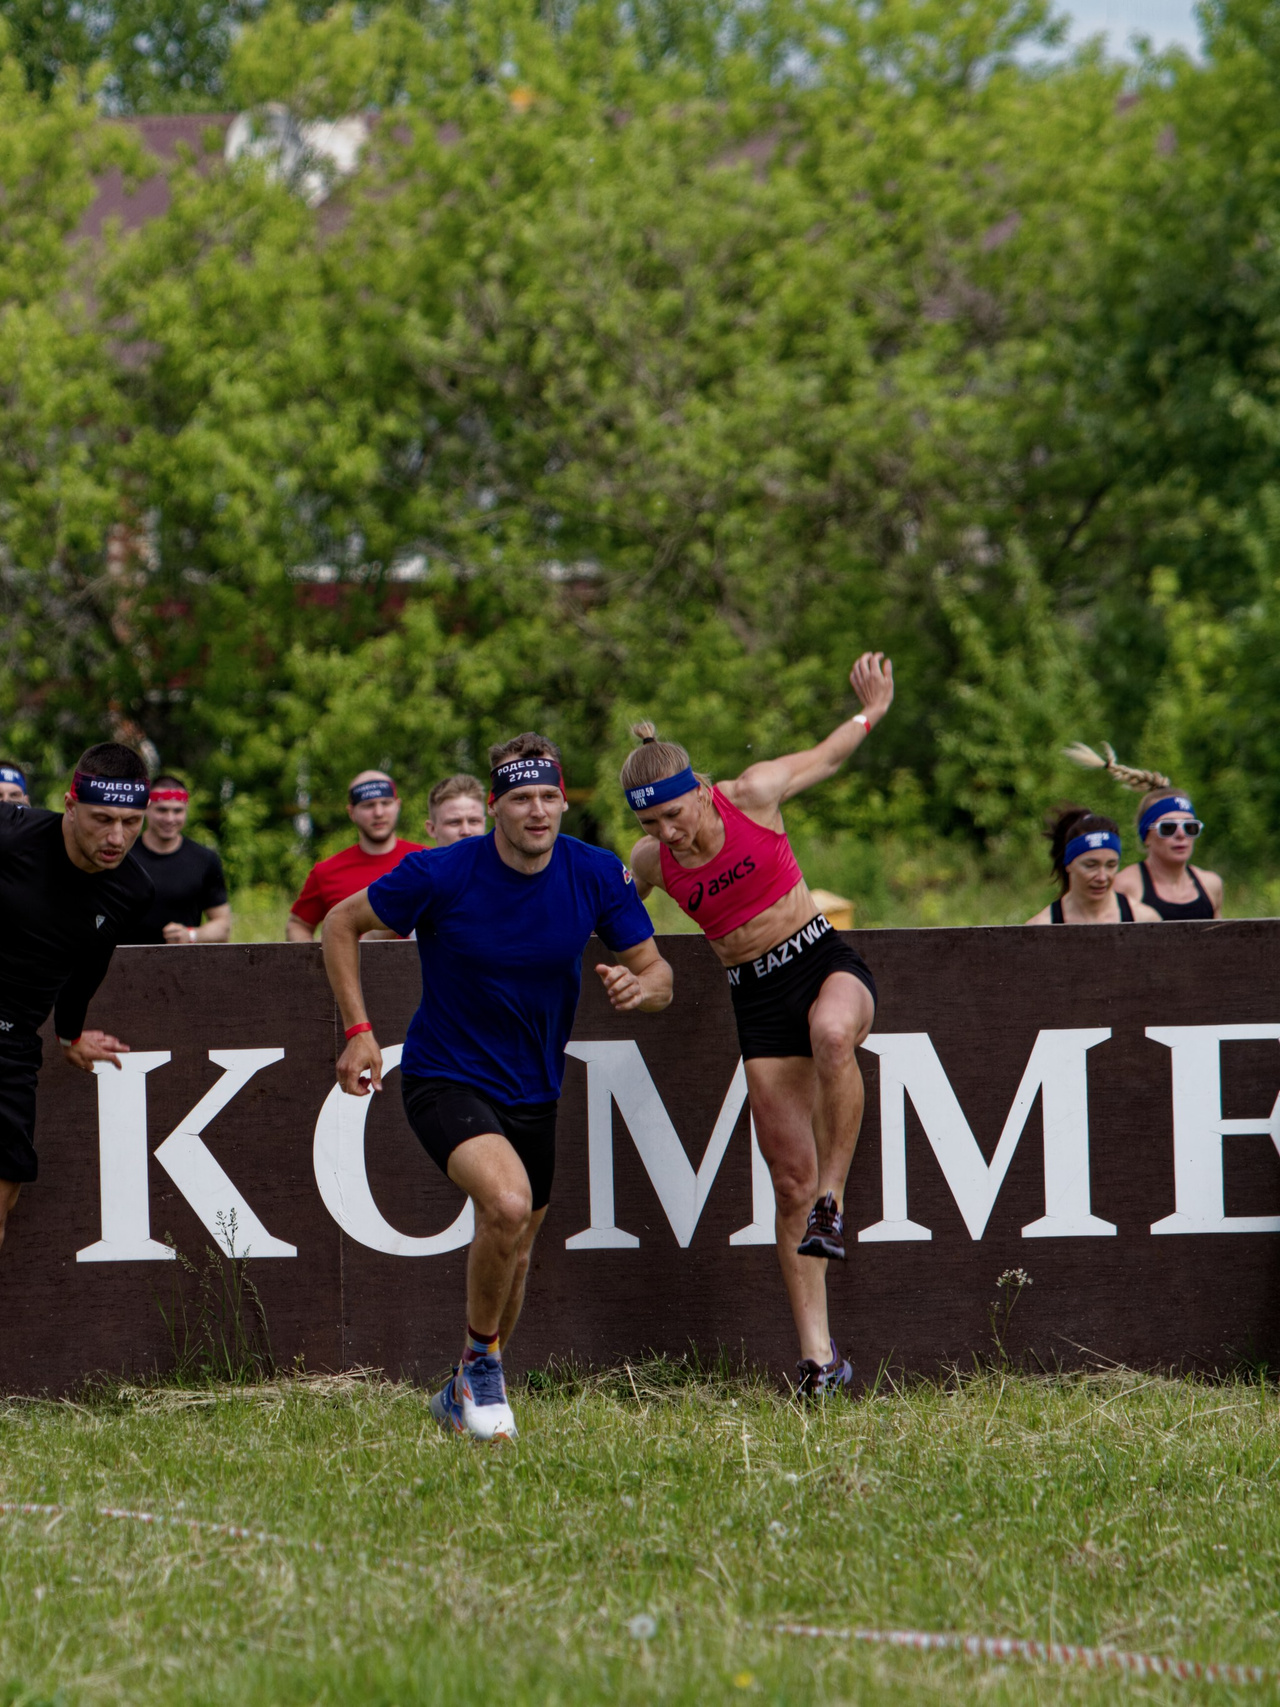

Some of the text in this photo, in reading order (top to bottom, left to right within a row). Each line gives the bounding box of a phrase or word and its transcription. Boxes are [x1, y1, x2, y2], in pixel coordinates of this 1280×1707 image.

[497, 759, 551, 776] РОДЕО 59
[508, 769, 539, 782] 2749
[90, 780, 145, 792] РОДЕО 59
[103, 792, 134, 803] 2756
